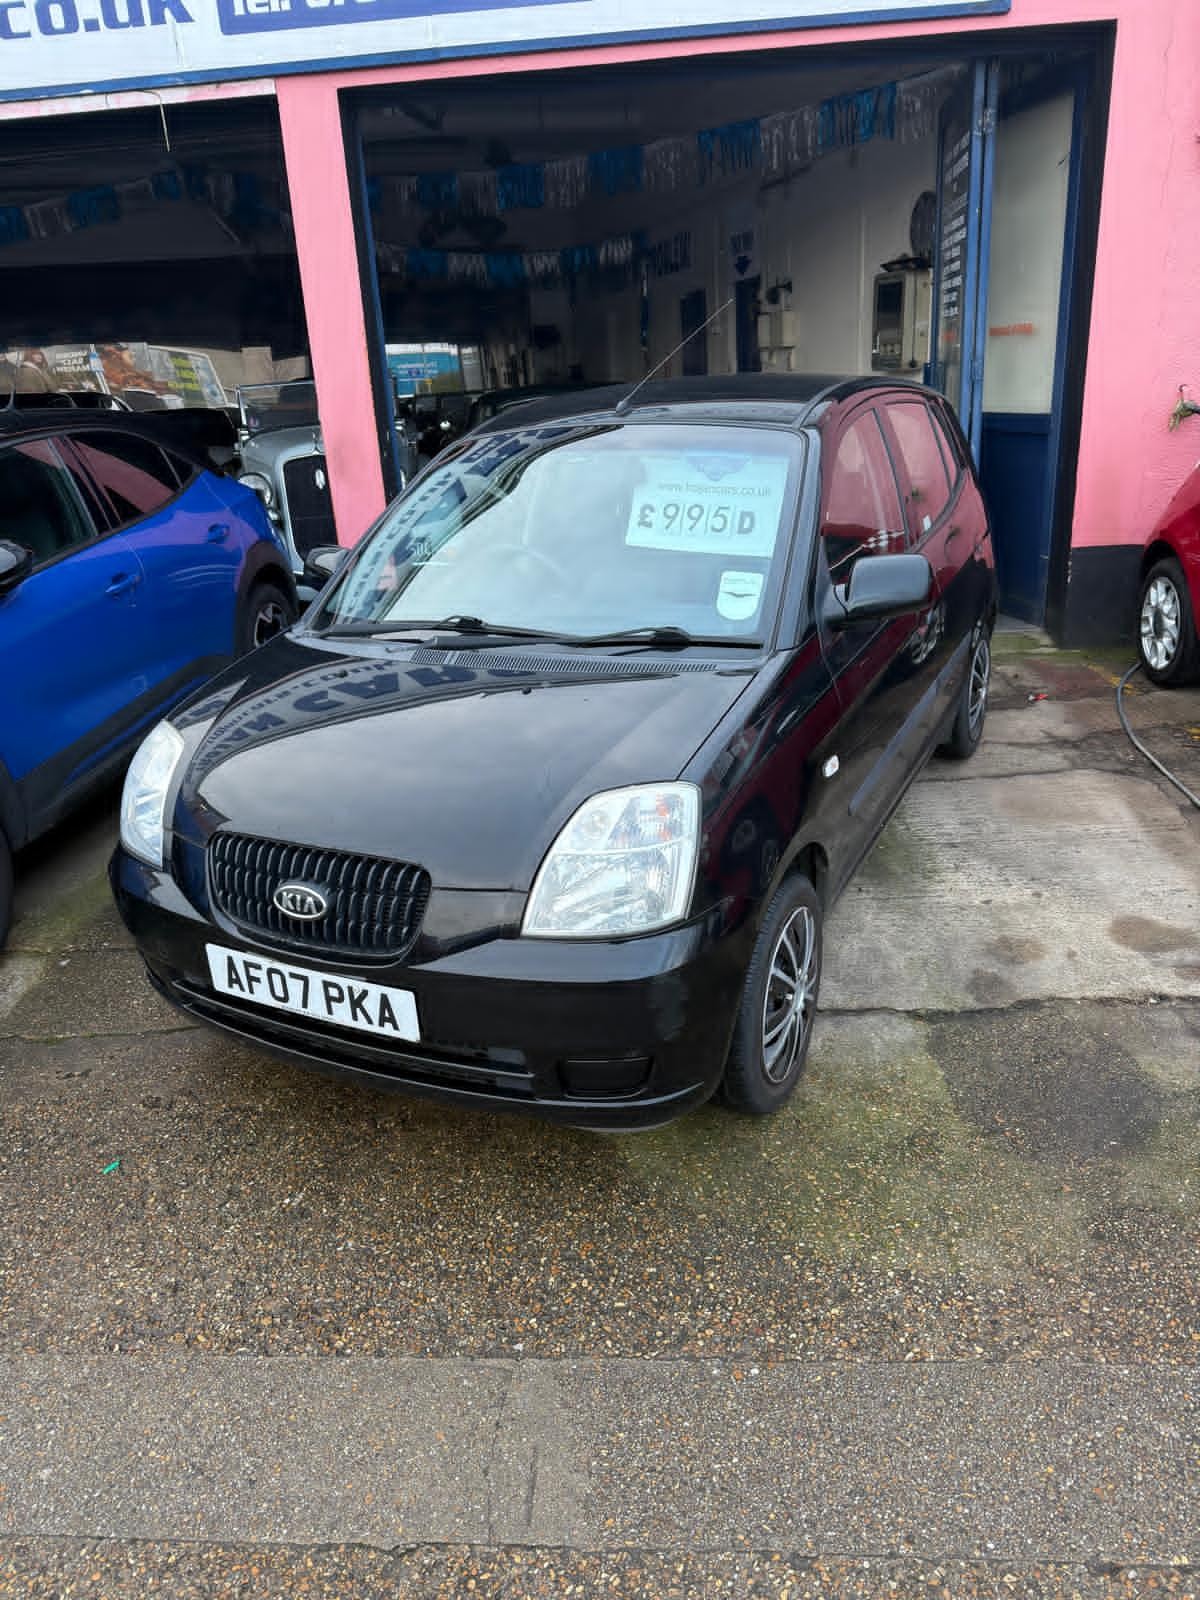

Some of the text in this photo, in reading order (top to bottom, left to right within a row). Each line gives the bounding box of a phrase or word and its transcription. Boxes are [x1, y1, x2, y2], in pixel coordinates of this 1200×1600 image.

[281, 891, 318, 914] KIA
[226, 955, 401, 1032] AF07 PKA
